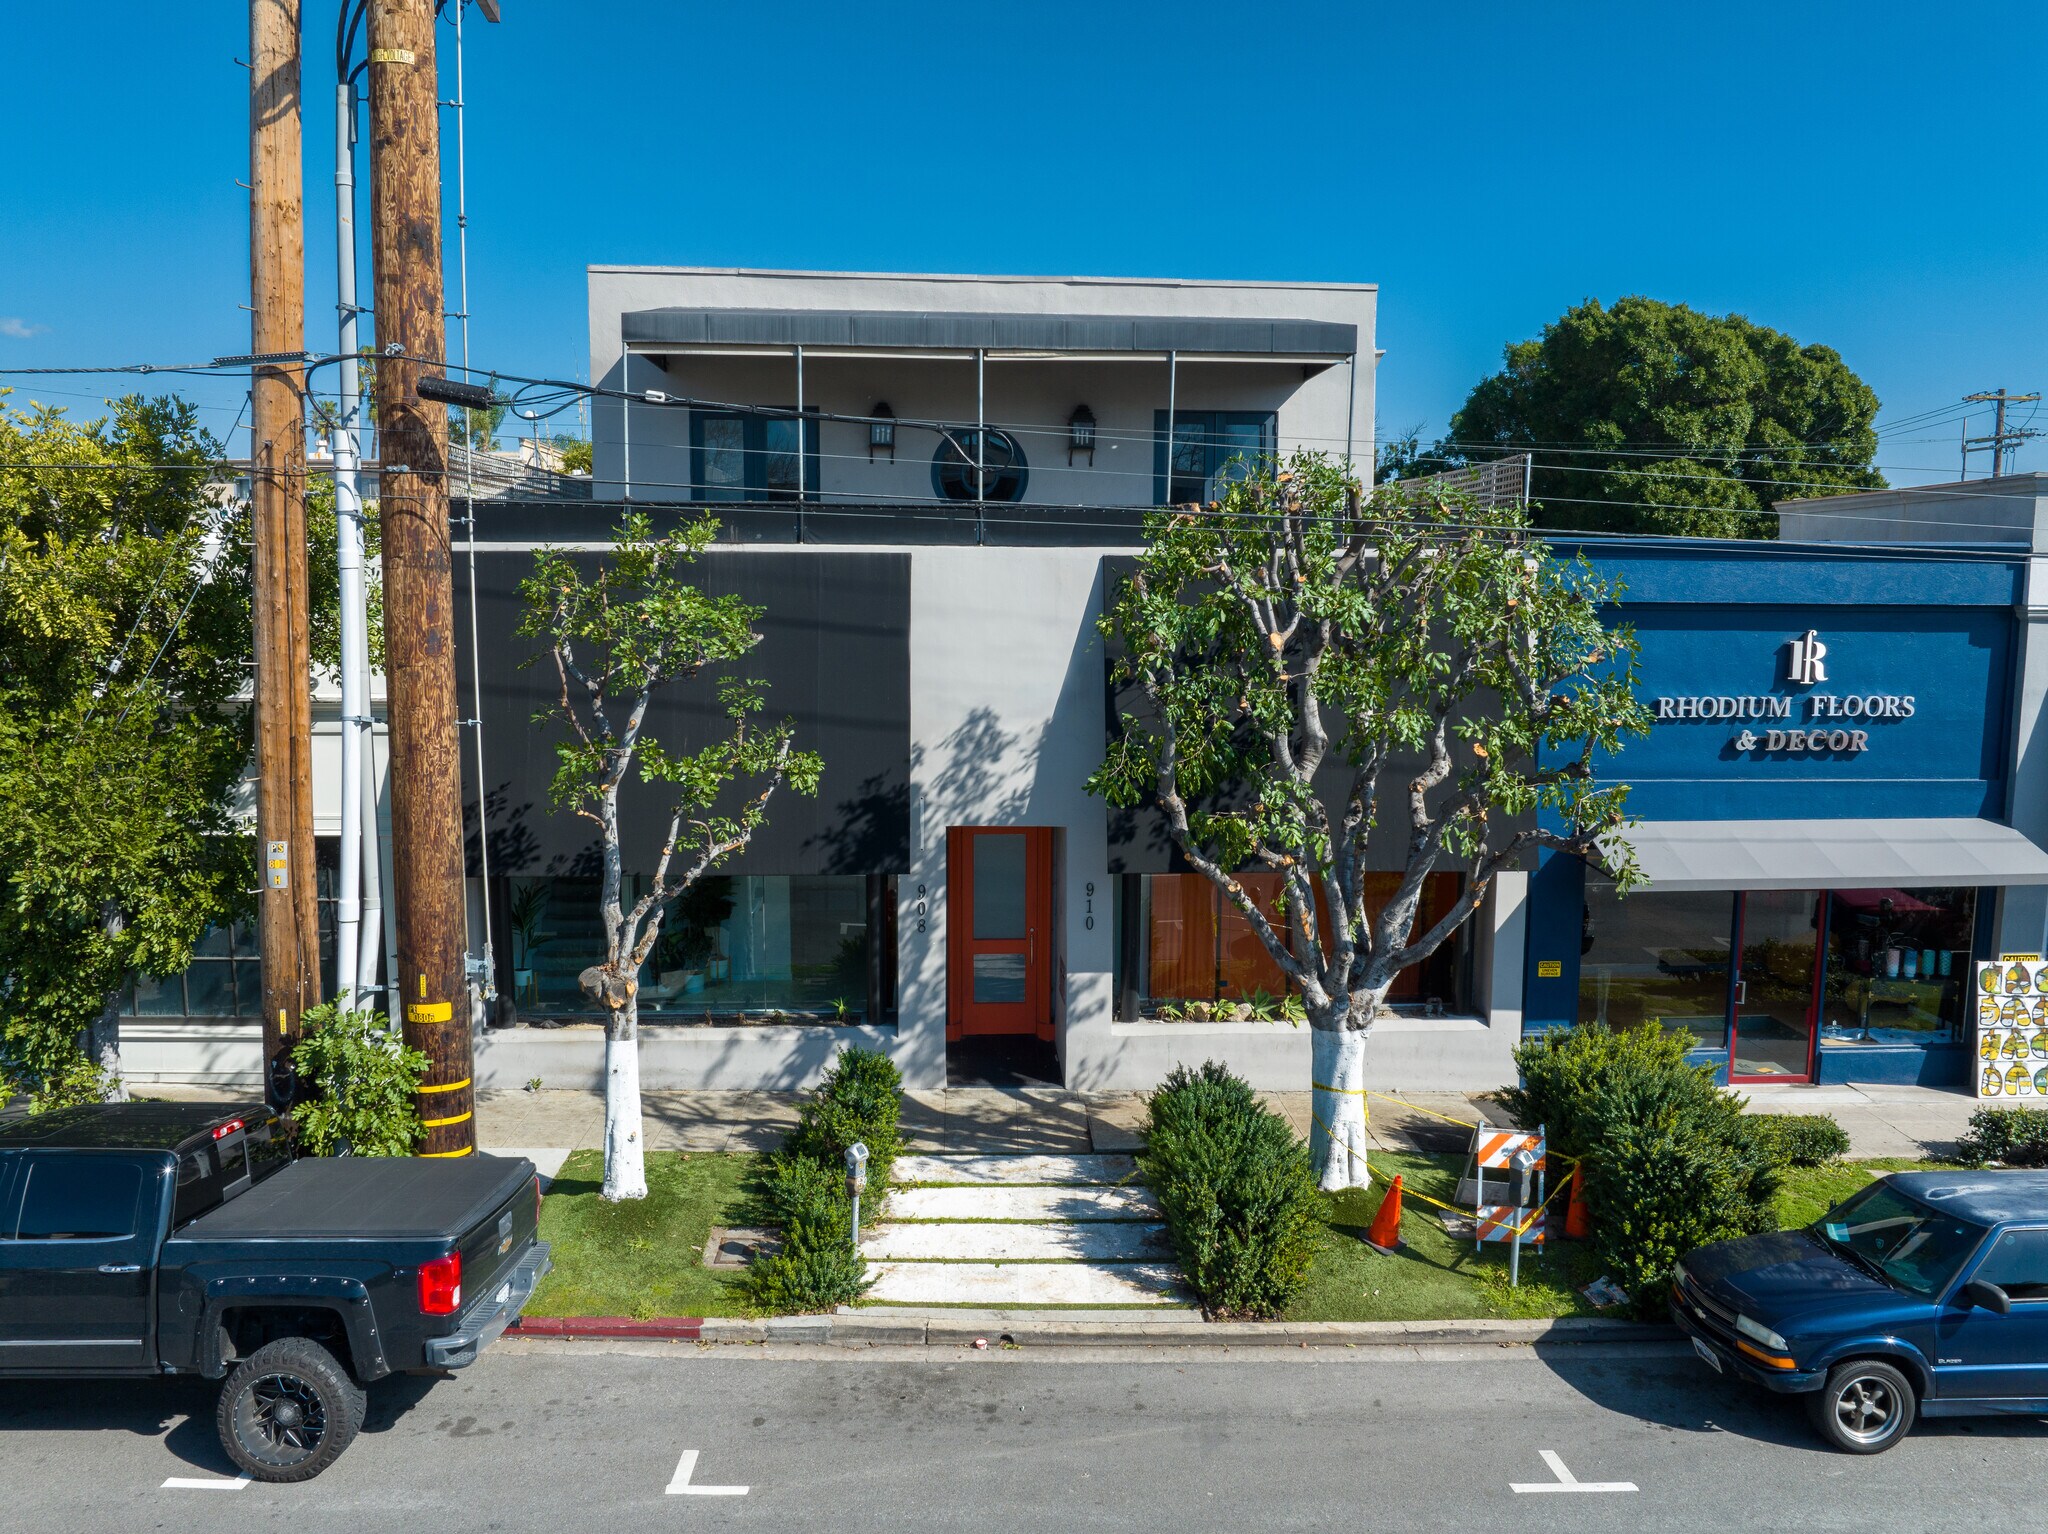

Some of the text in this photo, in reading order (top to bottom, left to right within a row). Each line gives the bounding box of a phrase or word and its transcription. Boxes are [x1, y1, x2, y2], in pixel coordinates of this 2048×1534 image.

[1657, 695, 1916, 719] RHODIUM FLOORS
[1735, 729, 1869, 752] & DECOR
[917, 884, 927, 934] 908
[1085, 882, 1095, 931] 910
